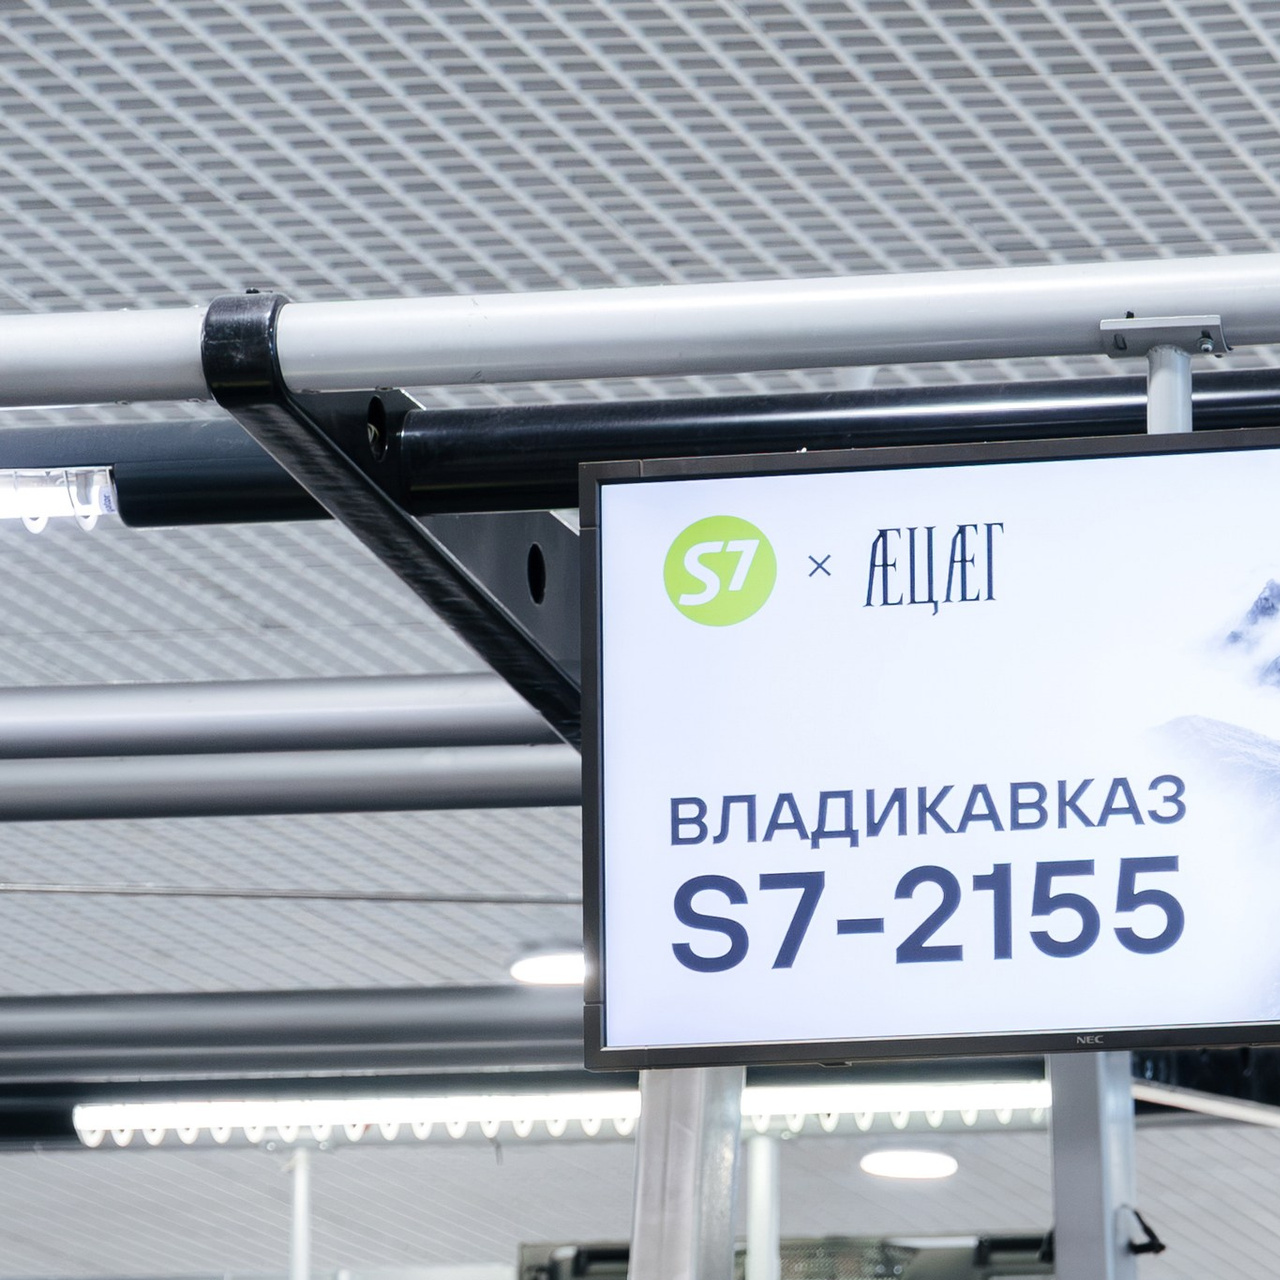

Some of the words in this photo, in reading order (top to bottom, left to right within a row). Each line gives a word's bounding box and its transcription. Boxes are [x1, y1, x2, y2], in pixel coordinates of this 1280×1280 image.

[678, 538, 760, 607] S7
[670, 774, 1188, 850] ВЛАДИКАВКАЗ
[671, 855, 1186, 973] S7-2155
[1076, 1034, 1105, 1045] NEC
